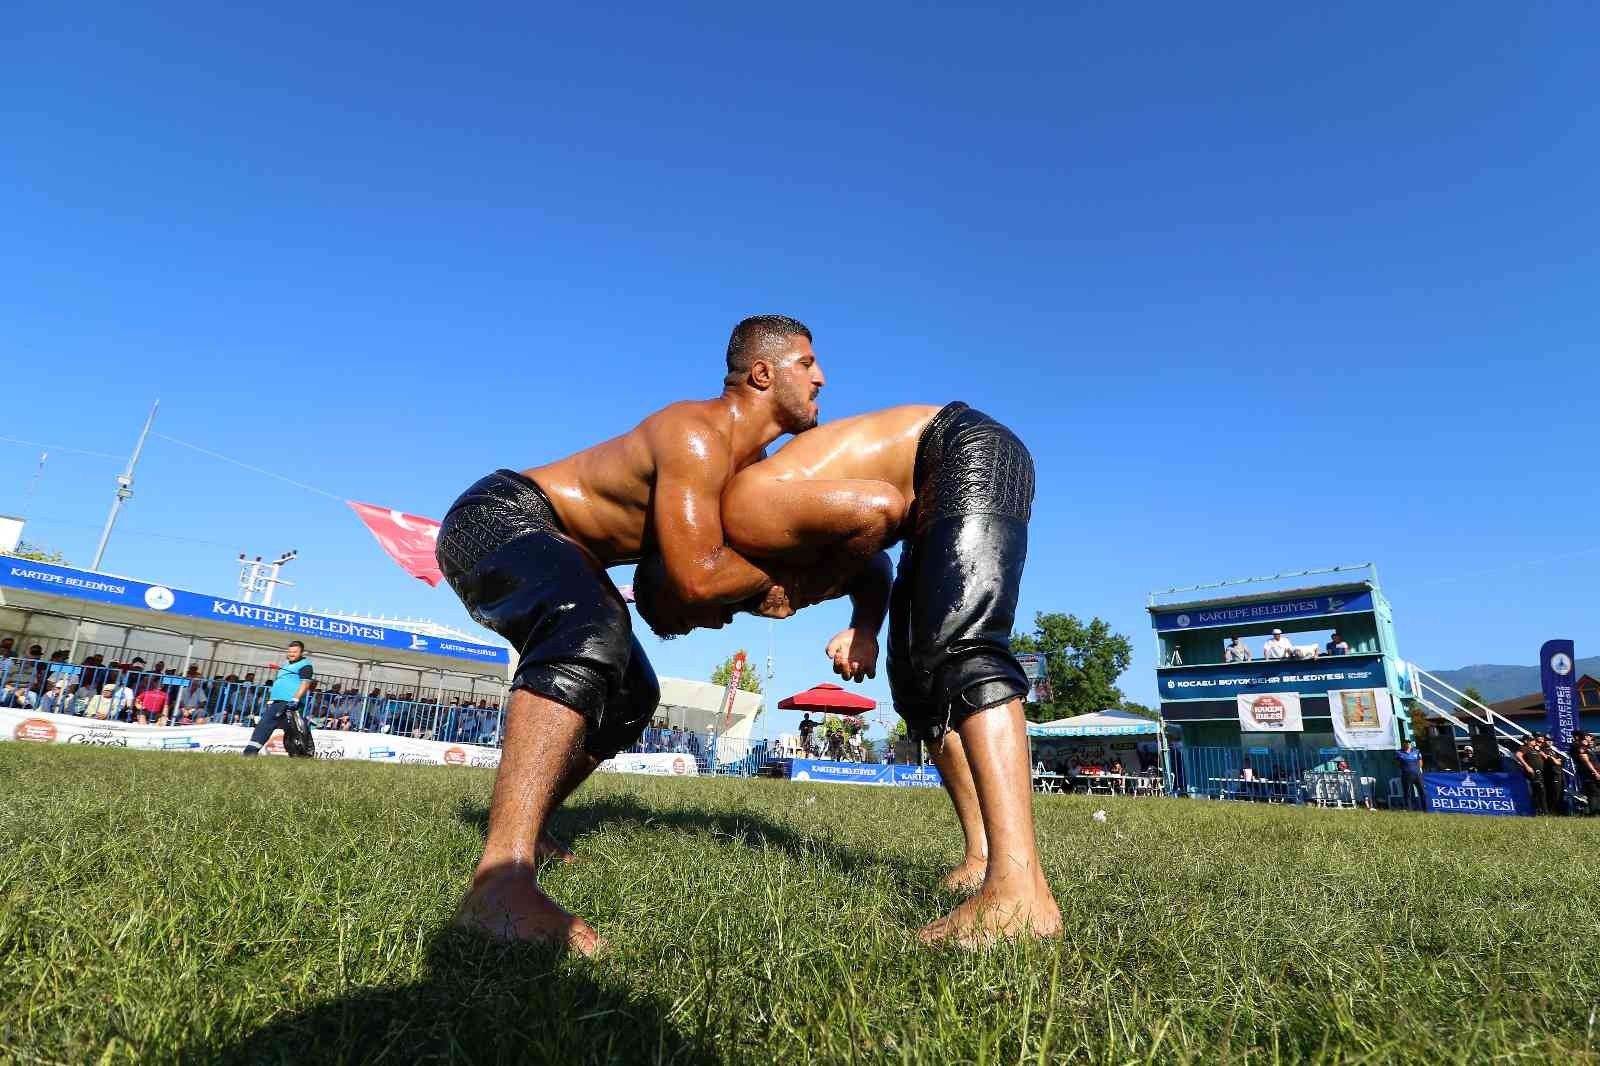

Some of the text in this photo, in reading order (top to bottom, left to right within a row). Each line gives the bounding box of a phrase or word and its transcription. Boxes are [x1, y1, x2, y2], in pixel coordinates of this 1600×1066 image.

[11, 566, 126, 595] KARTEPE BELEDİYESİ
[213, 601, 295, 625] KARTEPE
[299, 615, 385, 640] BELEDİYESİ
[1198, 606, 1250, 623] KARTEPE
[1435, 785, 1506, 799] KARTEPE
[1431, 797, 1516, 812] BELEDİYESİ
